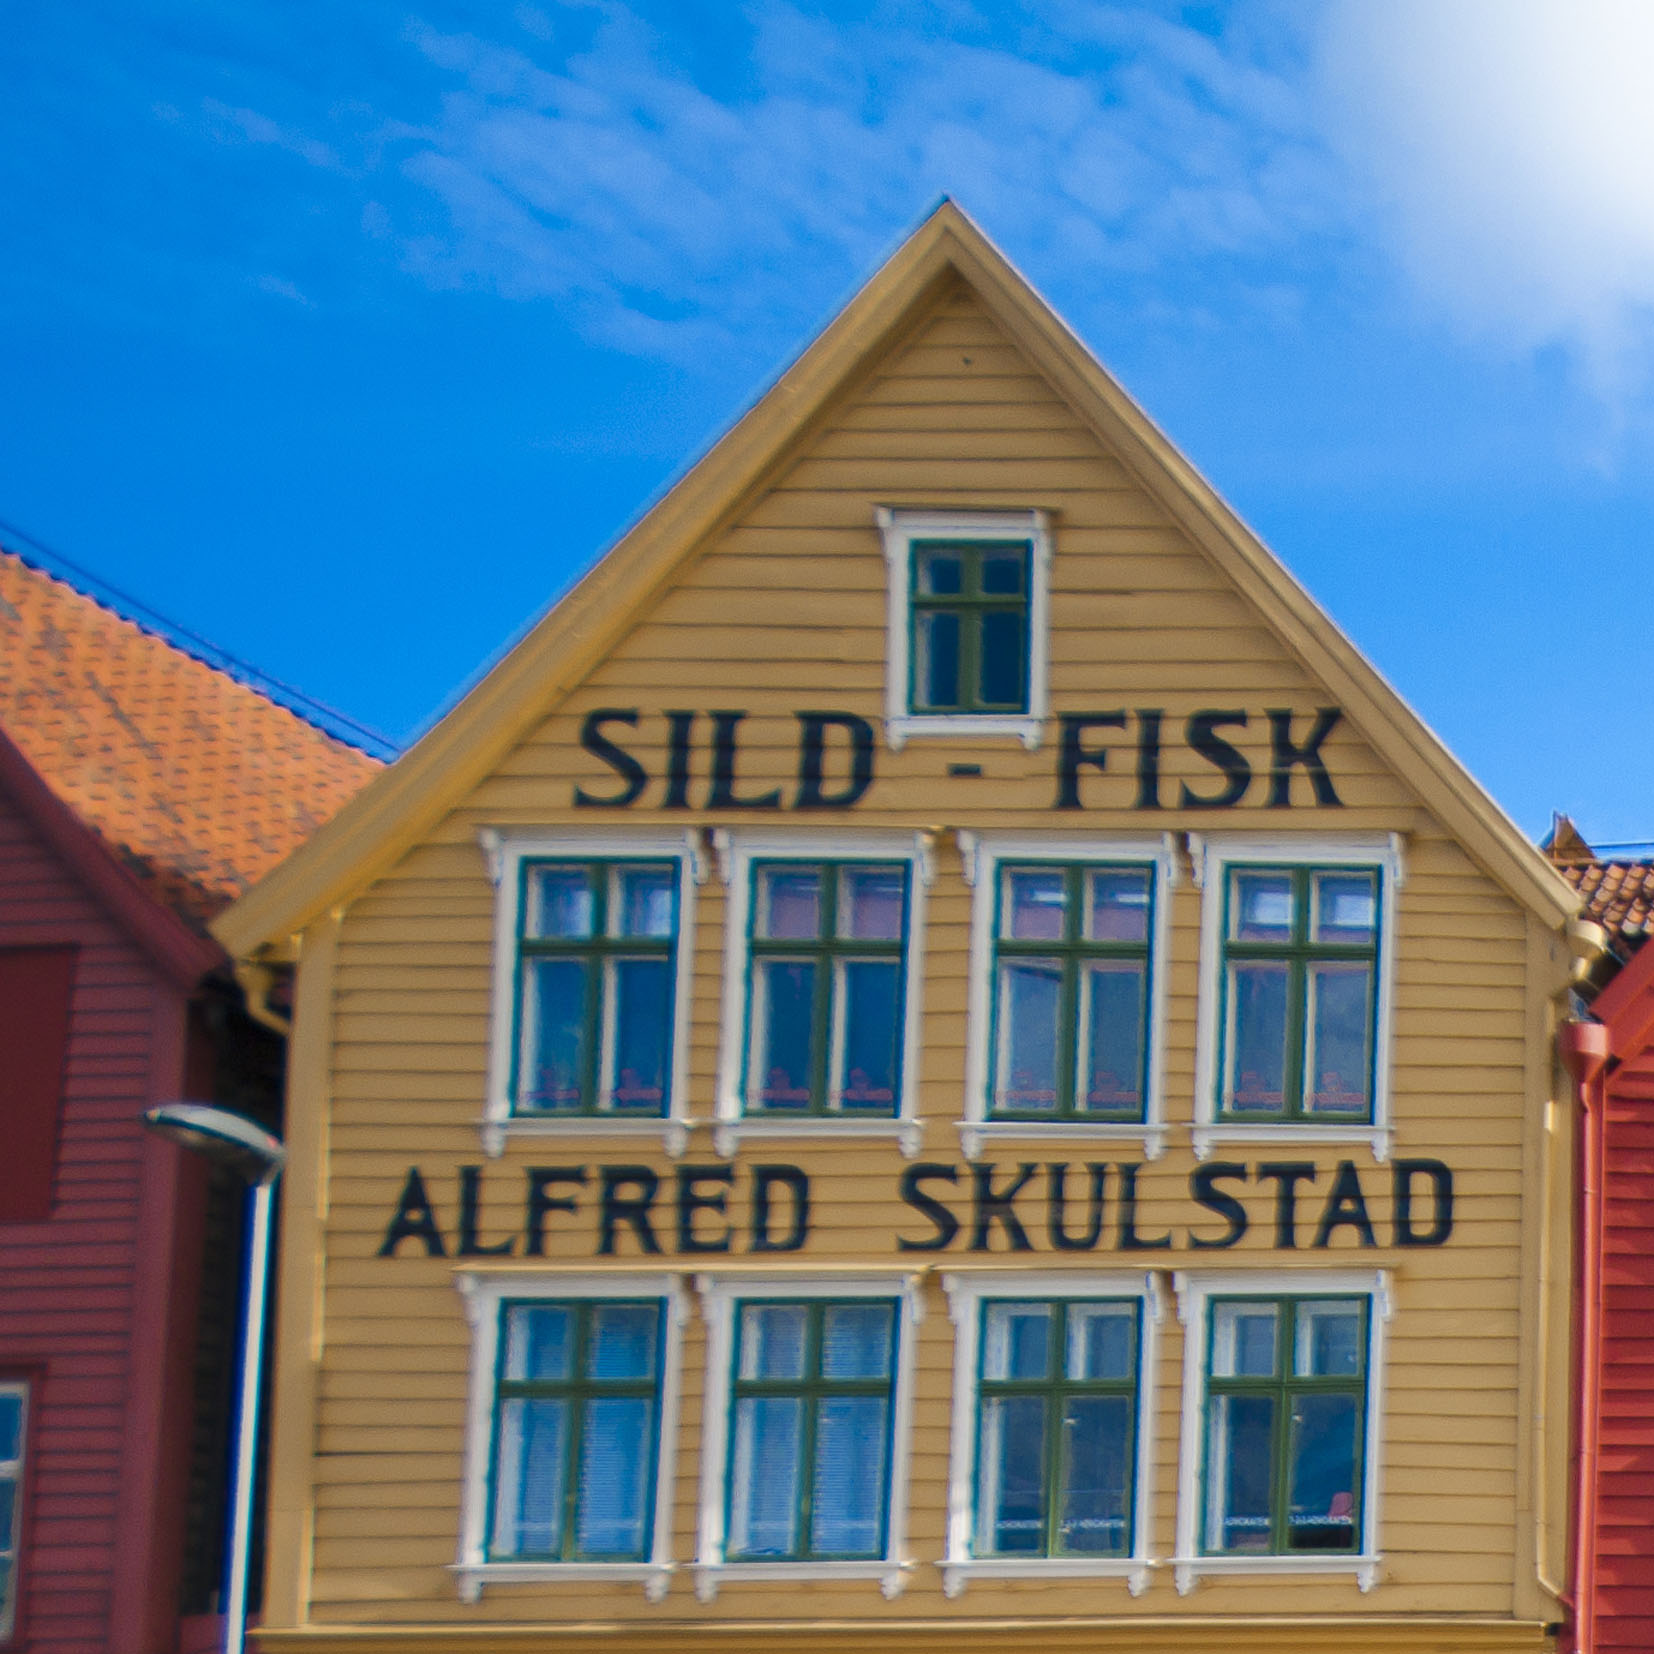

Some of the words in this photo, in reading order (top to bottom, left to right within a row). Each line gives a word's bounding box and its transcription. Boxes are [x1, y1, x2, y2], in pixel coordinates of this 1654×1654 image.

[572, 708, 875, 812] SILD
[1051, 706, 1347, 811] FISK
[377, 1163, 812, 1257] ALFRED
[896, 1157, 1454, 1252] SKULSTAD
